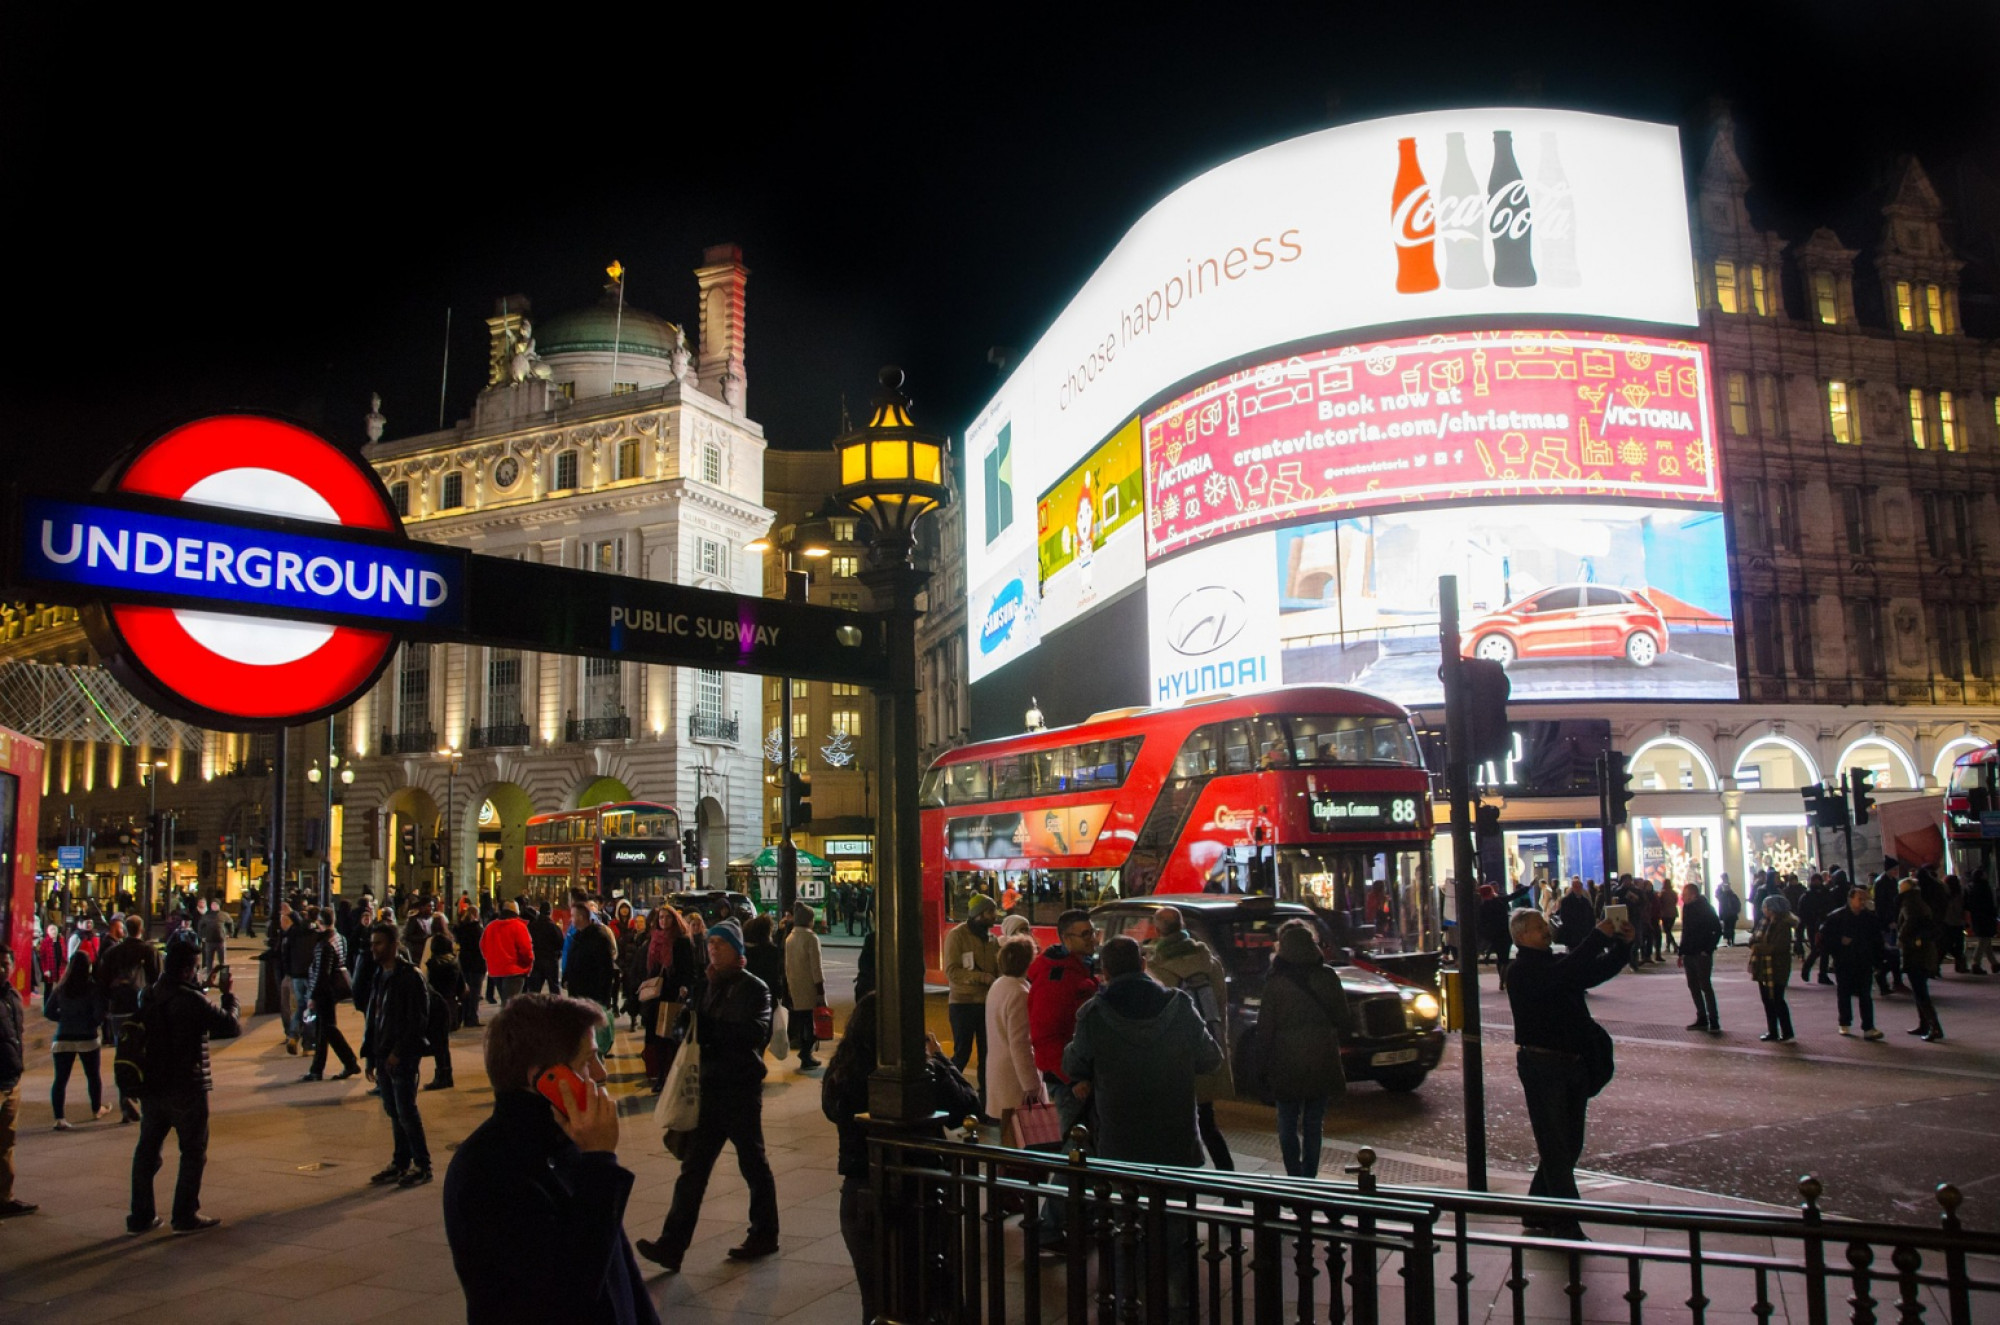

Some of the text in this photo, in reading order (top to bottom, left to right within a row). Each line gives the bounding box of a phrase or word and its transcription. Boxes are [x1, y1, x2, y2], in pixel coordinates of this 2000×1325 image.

[1059, 229, 1302, 411] choose happiness
[1318, 386, 1462, 421] Book now at
[1233, 409, 1569, 467] createvictoria.com/christmas
[41, 519, 449, 608] UNDERGROUND
[611, 606, 780, 646] PUBLIC SUBWAY
[984, 595, 1020, 638] SAMSUNG
[1158, 655, 1267, 702] HYUNDAI
[1314, 799, 1416, 822] Clapham Common 88
[616, 851, 666, 862] Aldwych 6
